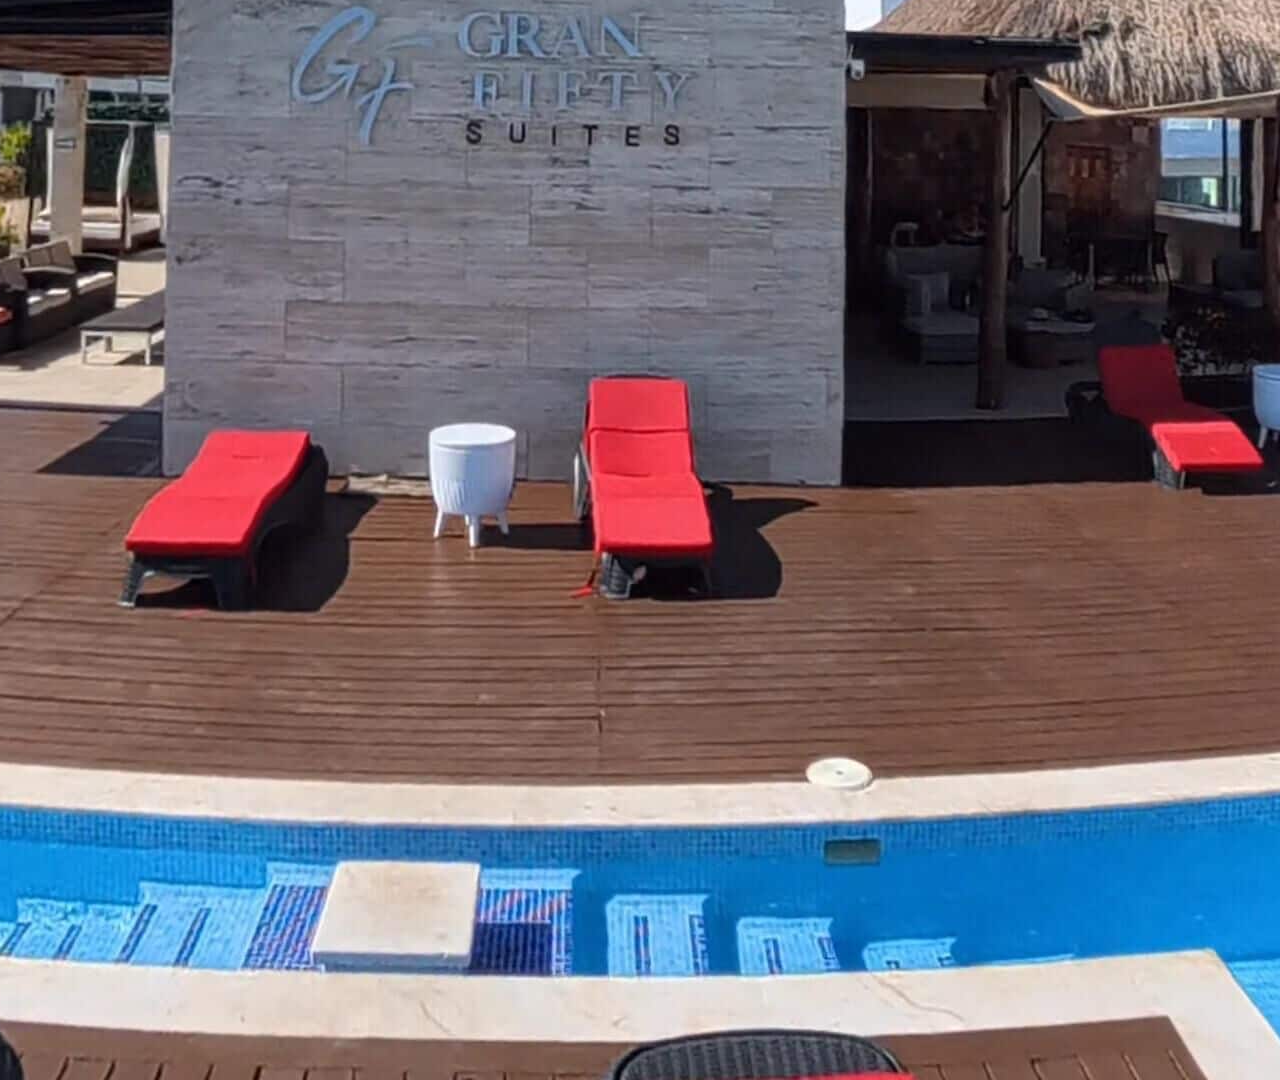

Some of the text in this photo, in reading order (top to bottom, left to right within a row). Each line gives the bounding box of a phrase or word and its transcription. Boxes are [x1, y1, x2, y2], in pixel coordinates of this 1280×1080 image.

[458, 11, 645, 58] GRAN
[473, 70, 692, 113] FIFTY
[466, 122, 681, 146] SUITES
